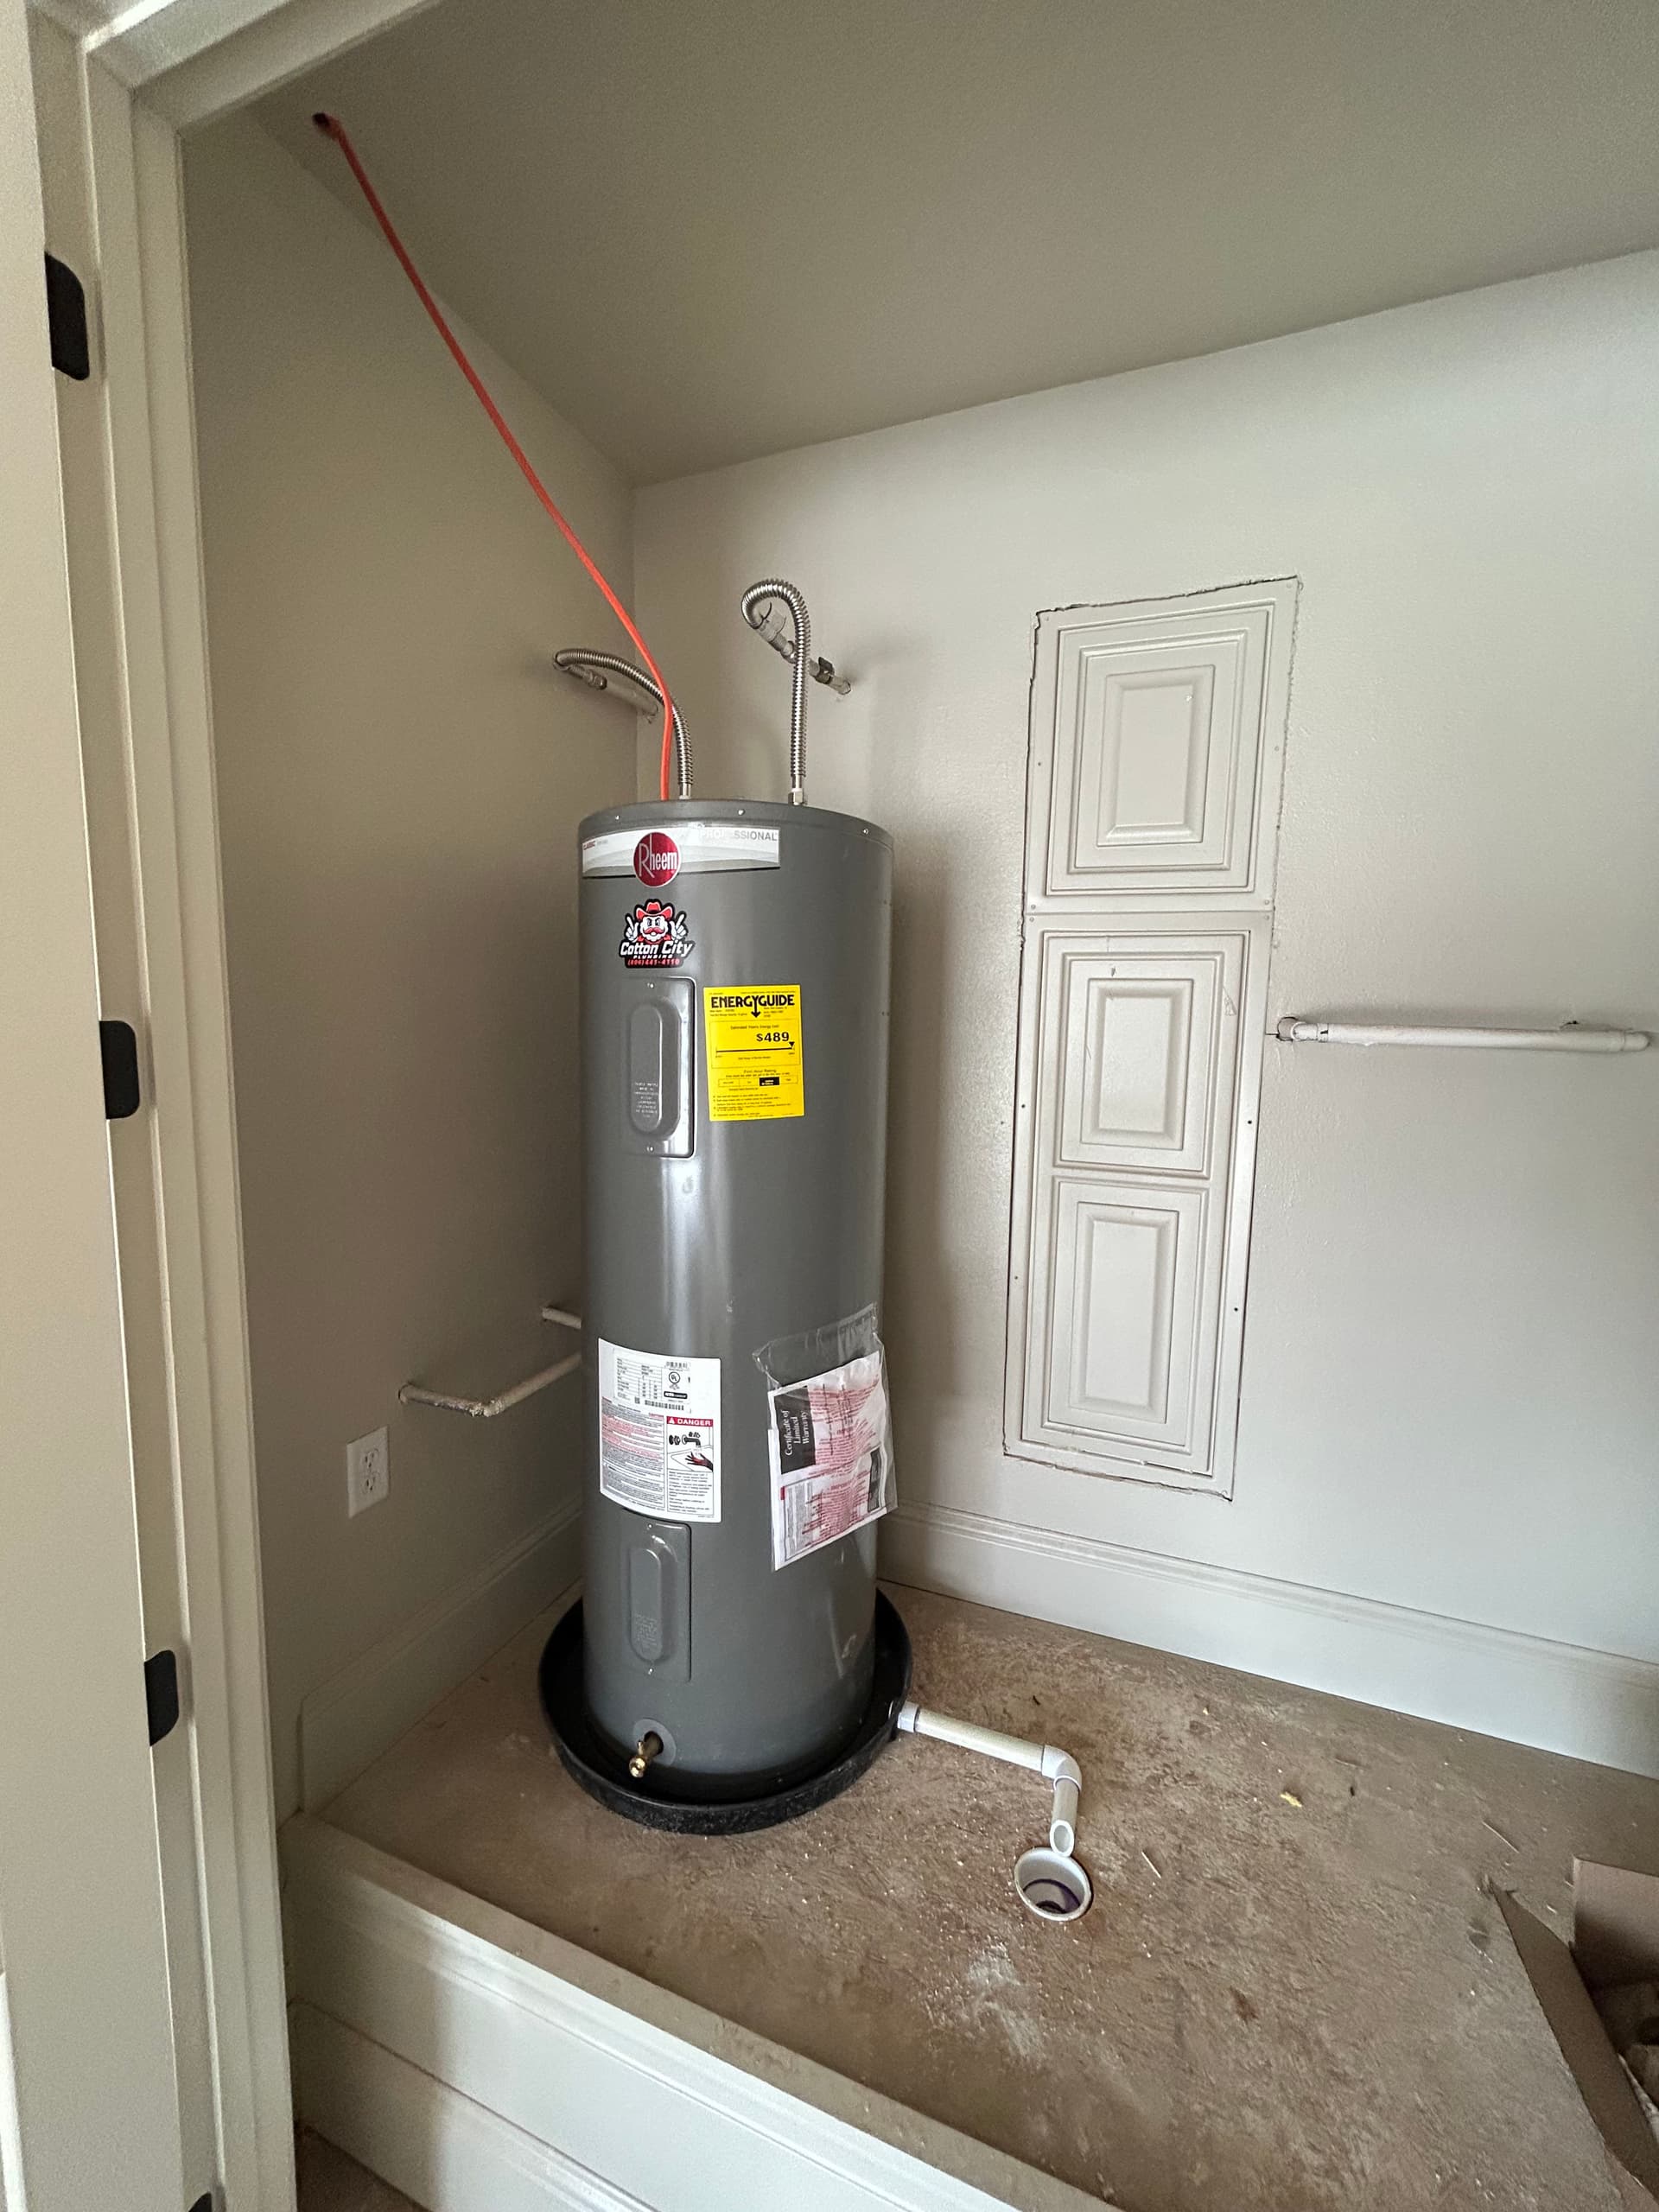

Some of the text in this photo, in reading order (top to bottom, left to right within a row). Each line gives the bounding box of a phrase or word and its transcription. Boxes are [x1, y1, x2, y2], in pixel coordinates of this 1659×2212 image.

[639, 833, 677, 879] Rheem
[620, 939, 693, 957] Cotton City
[711, 994, 795, 1008] ENERGYGUIDE
[756, 1031, 790, 1042] $489
[781, 1409, 793, 1455] Certificate of
[790, 1416, 801, 1443] Limited
